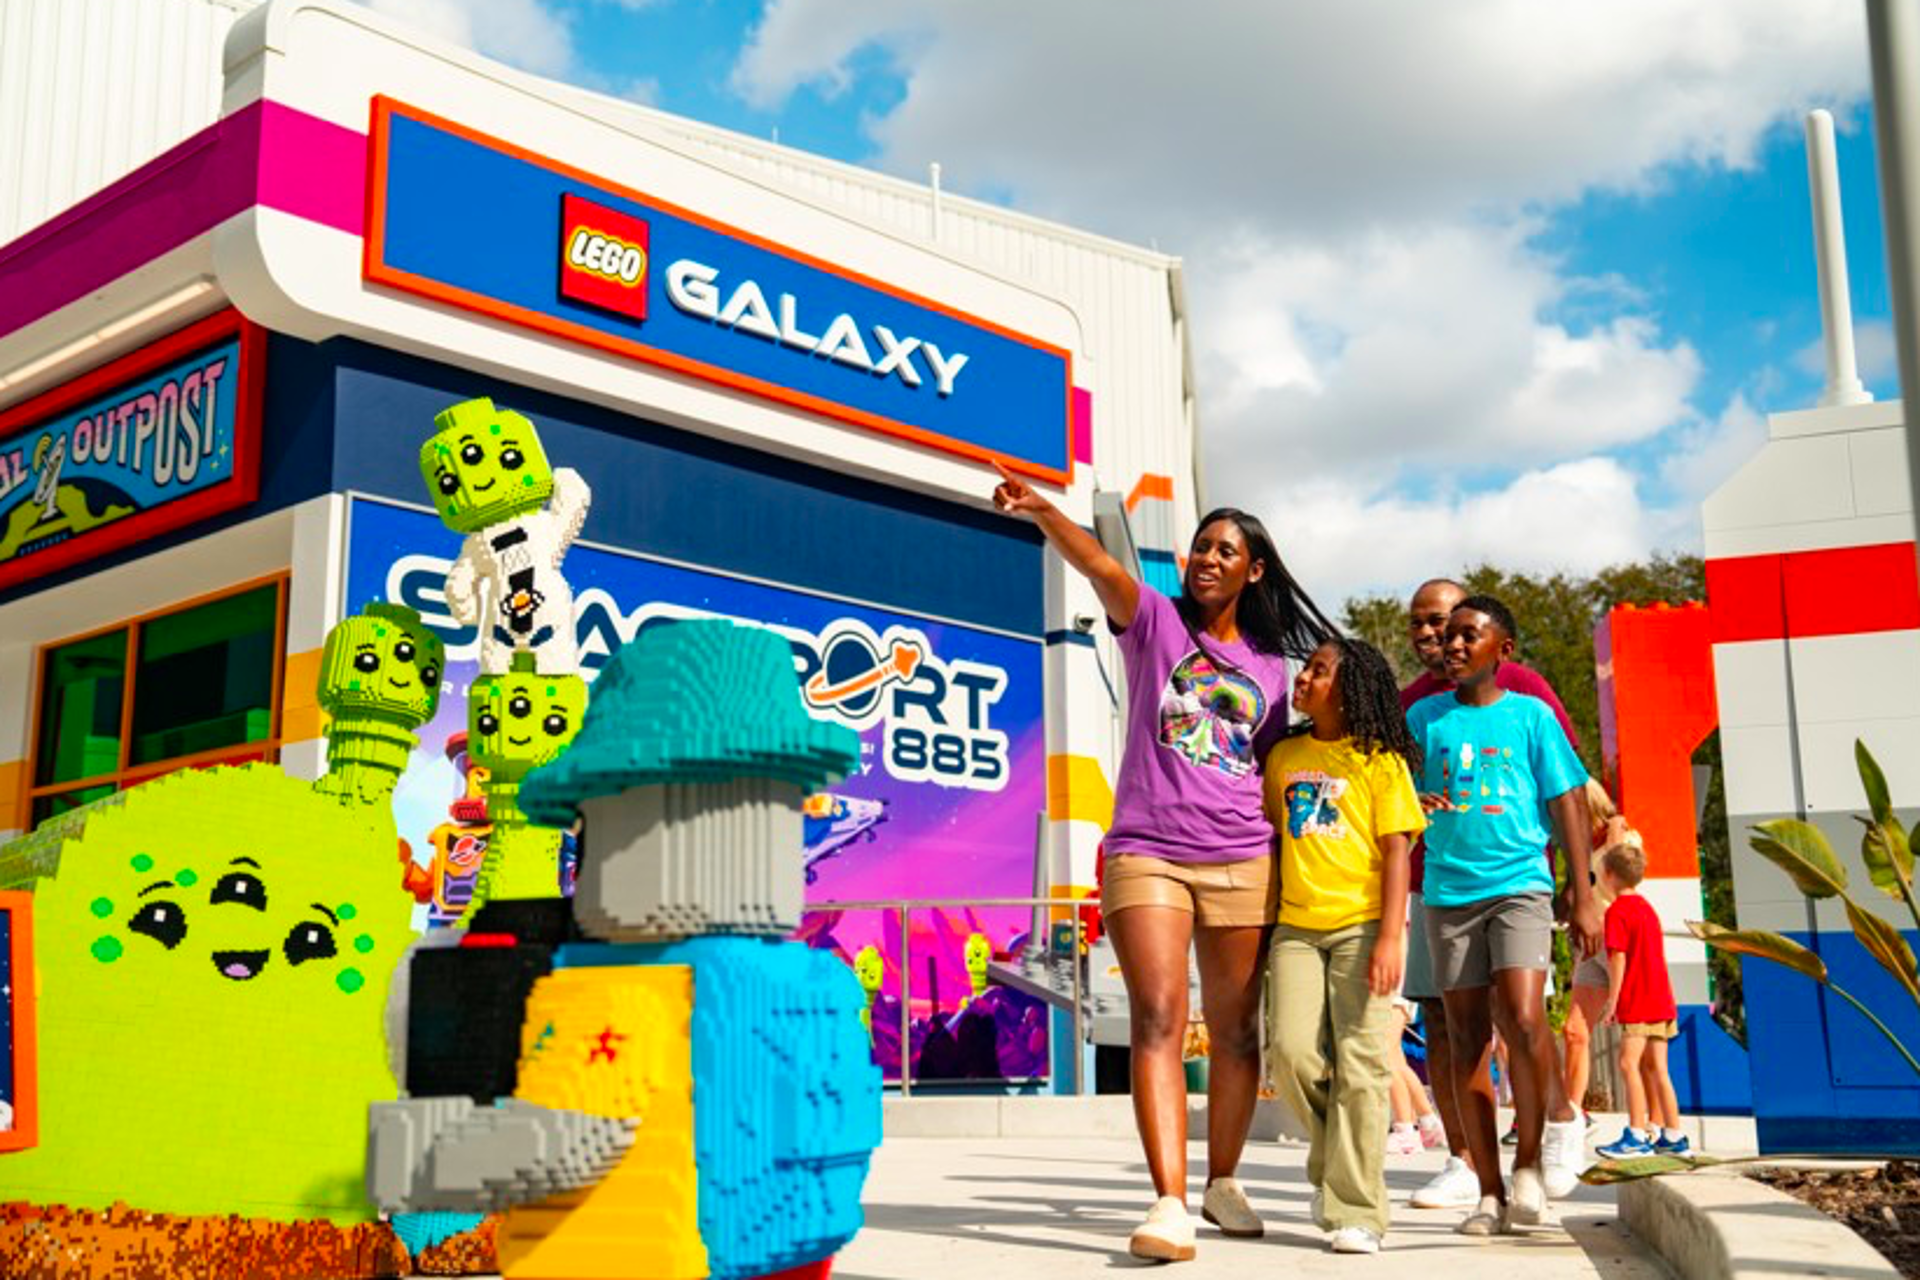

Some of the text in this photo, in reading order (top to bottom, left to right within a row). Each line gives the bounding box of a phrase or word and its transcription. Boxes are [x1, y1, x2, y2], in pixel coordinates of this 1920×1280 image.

[569, 229, 970, 397] LEGO GALAXY
[72, 359, 226, 485] OUTPOST
[892, 726, 1002, 780] 885
